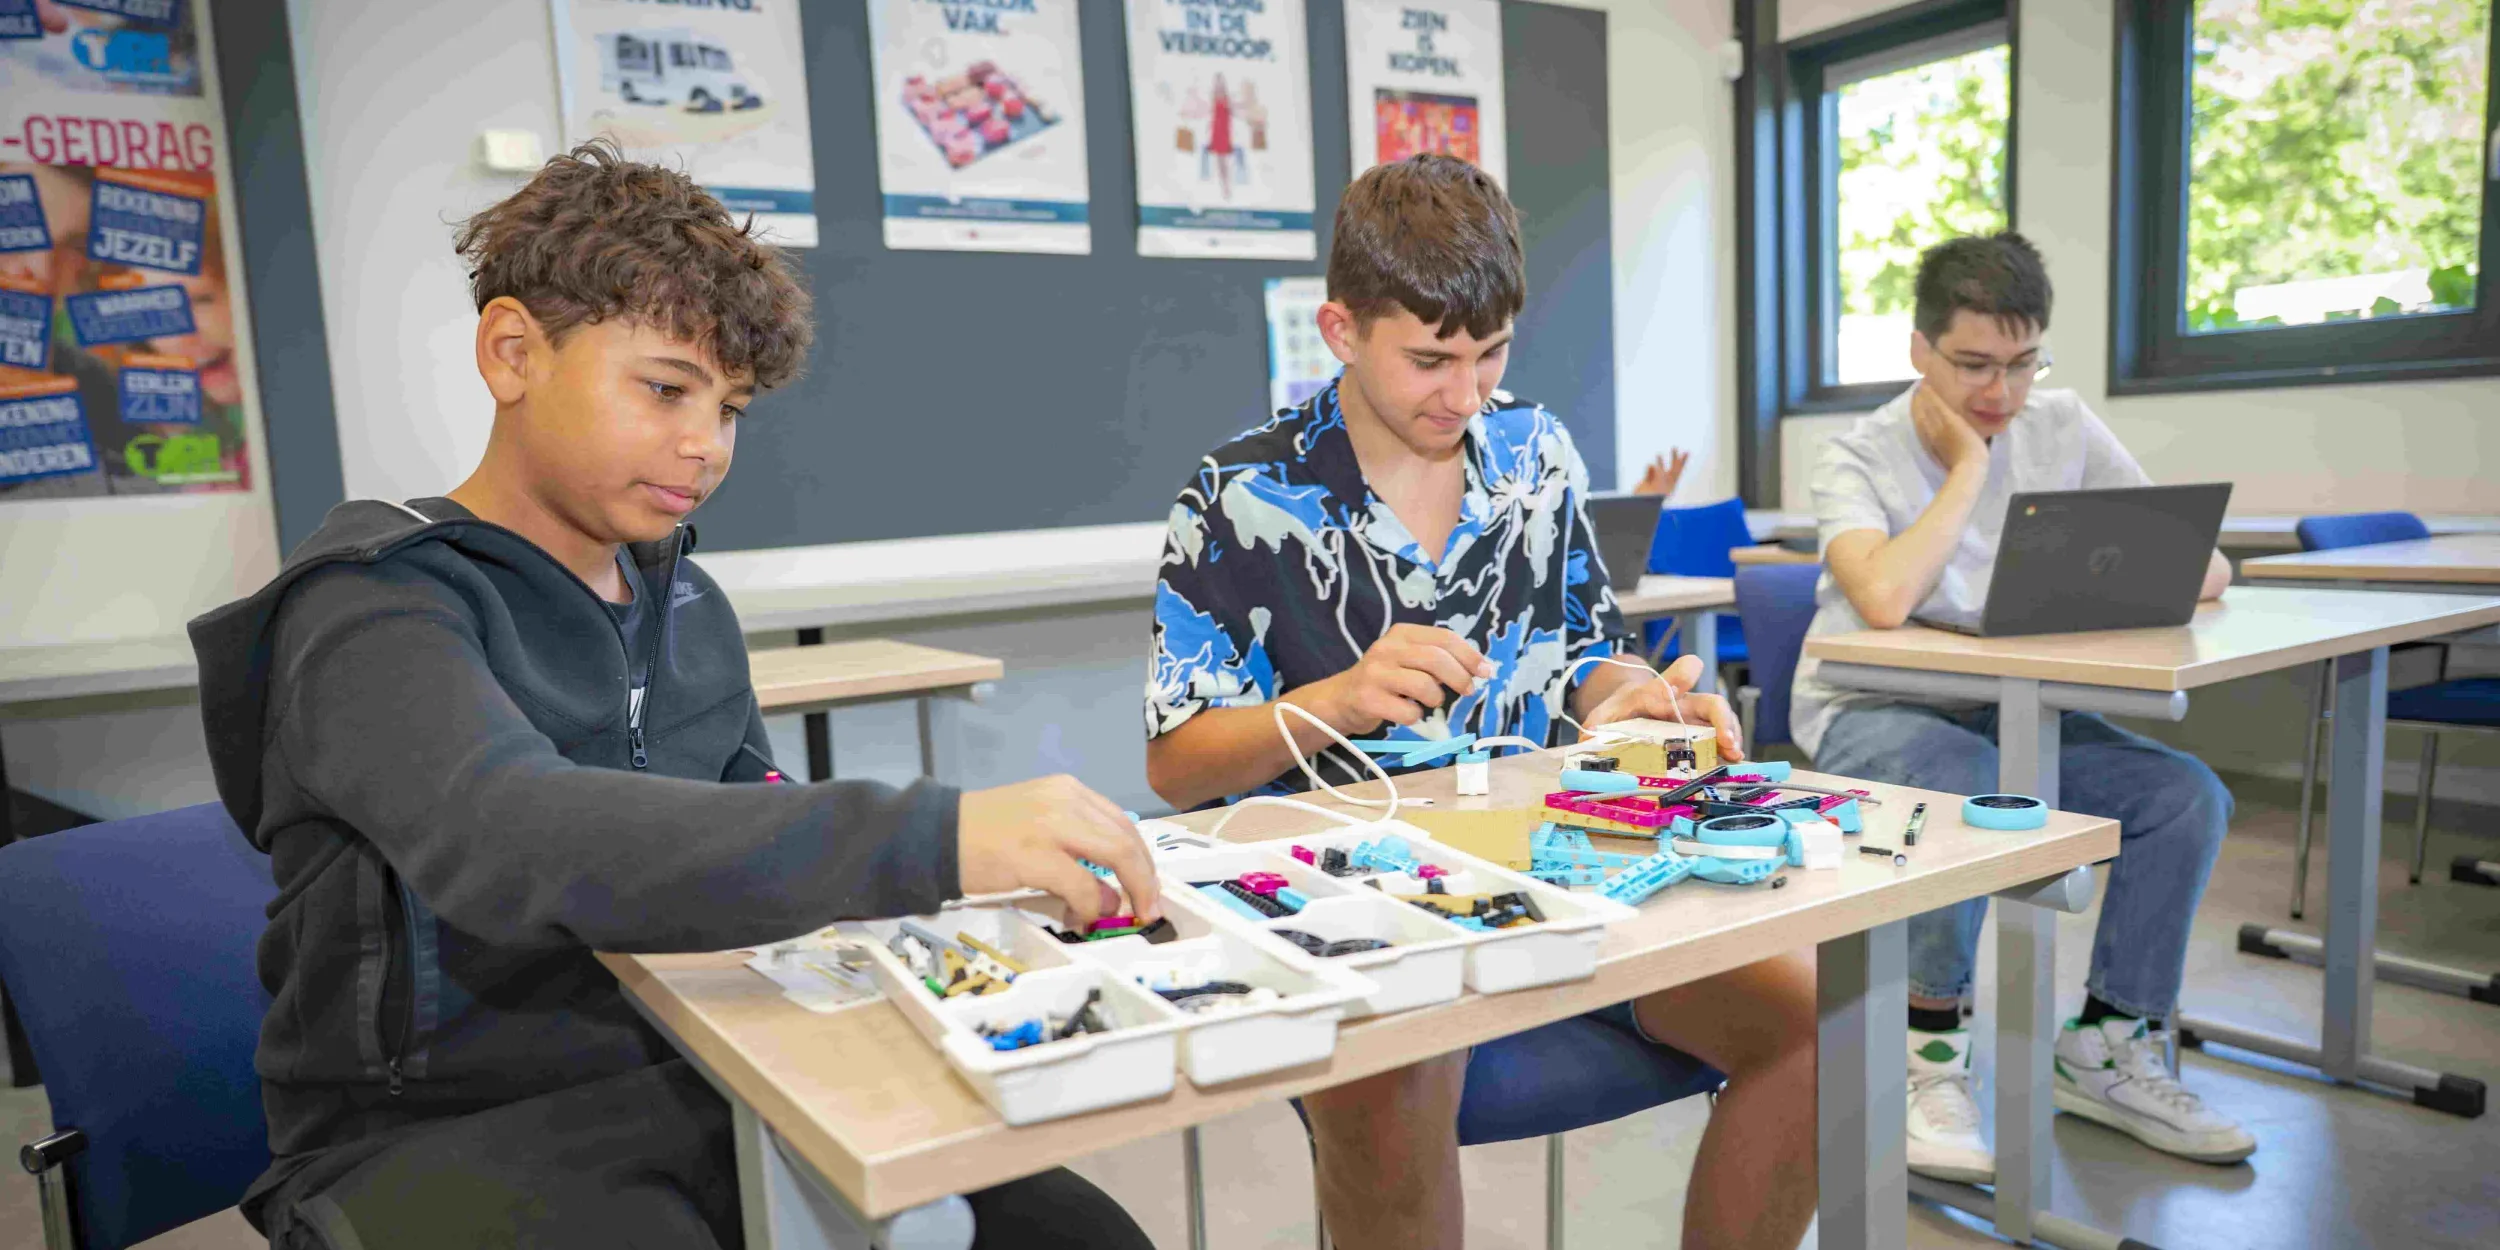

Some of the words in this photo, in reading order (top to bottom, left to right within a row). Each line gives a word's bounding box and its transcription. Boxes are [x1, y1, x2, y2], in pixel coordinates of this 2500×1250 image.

[943, 8, 1009, 35] VAK.
[1186, 10, 1211, 29] IN
[1218, 14, 1246, 34] DE
[1401, 9, 1447, 31] ZIEN
[1158, 31, 1276, 62] VERKOOP.
[1417, 34, 1434, 52] IS
[1388, 53, 1463, 77] KOPEN.
[100, 181, 199, 224] REKENING
[94, 228, 197, 270] JEZELF
[124, 393, 198, 421] ZIJN
